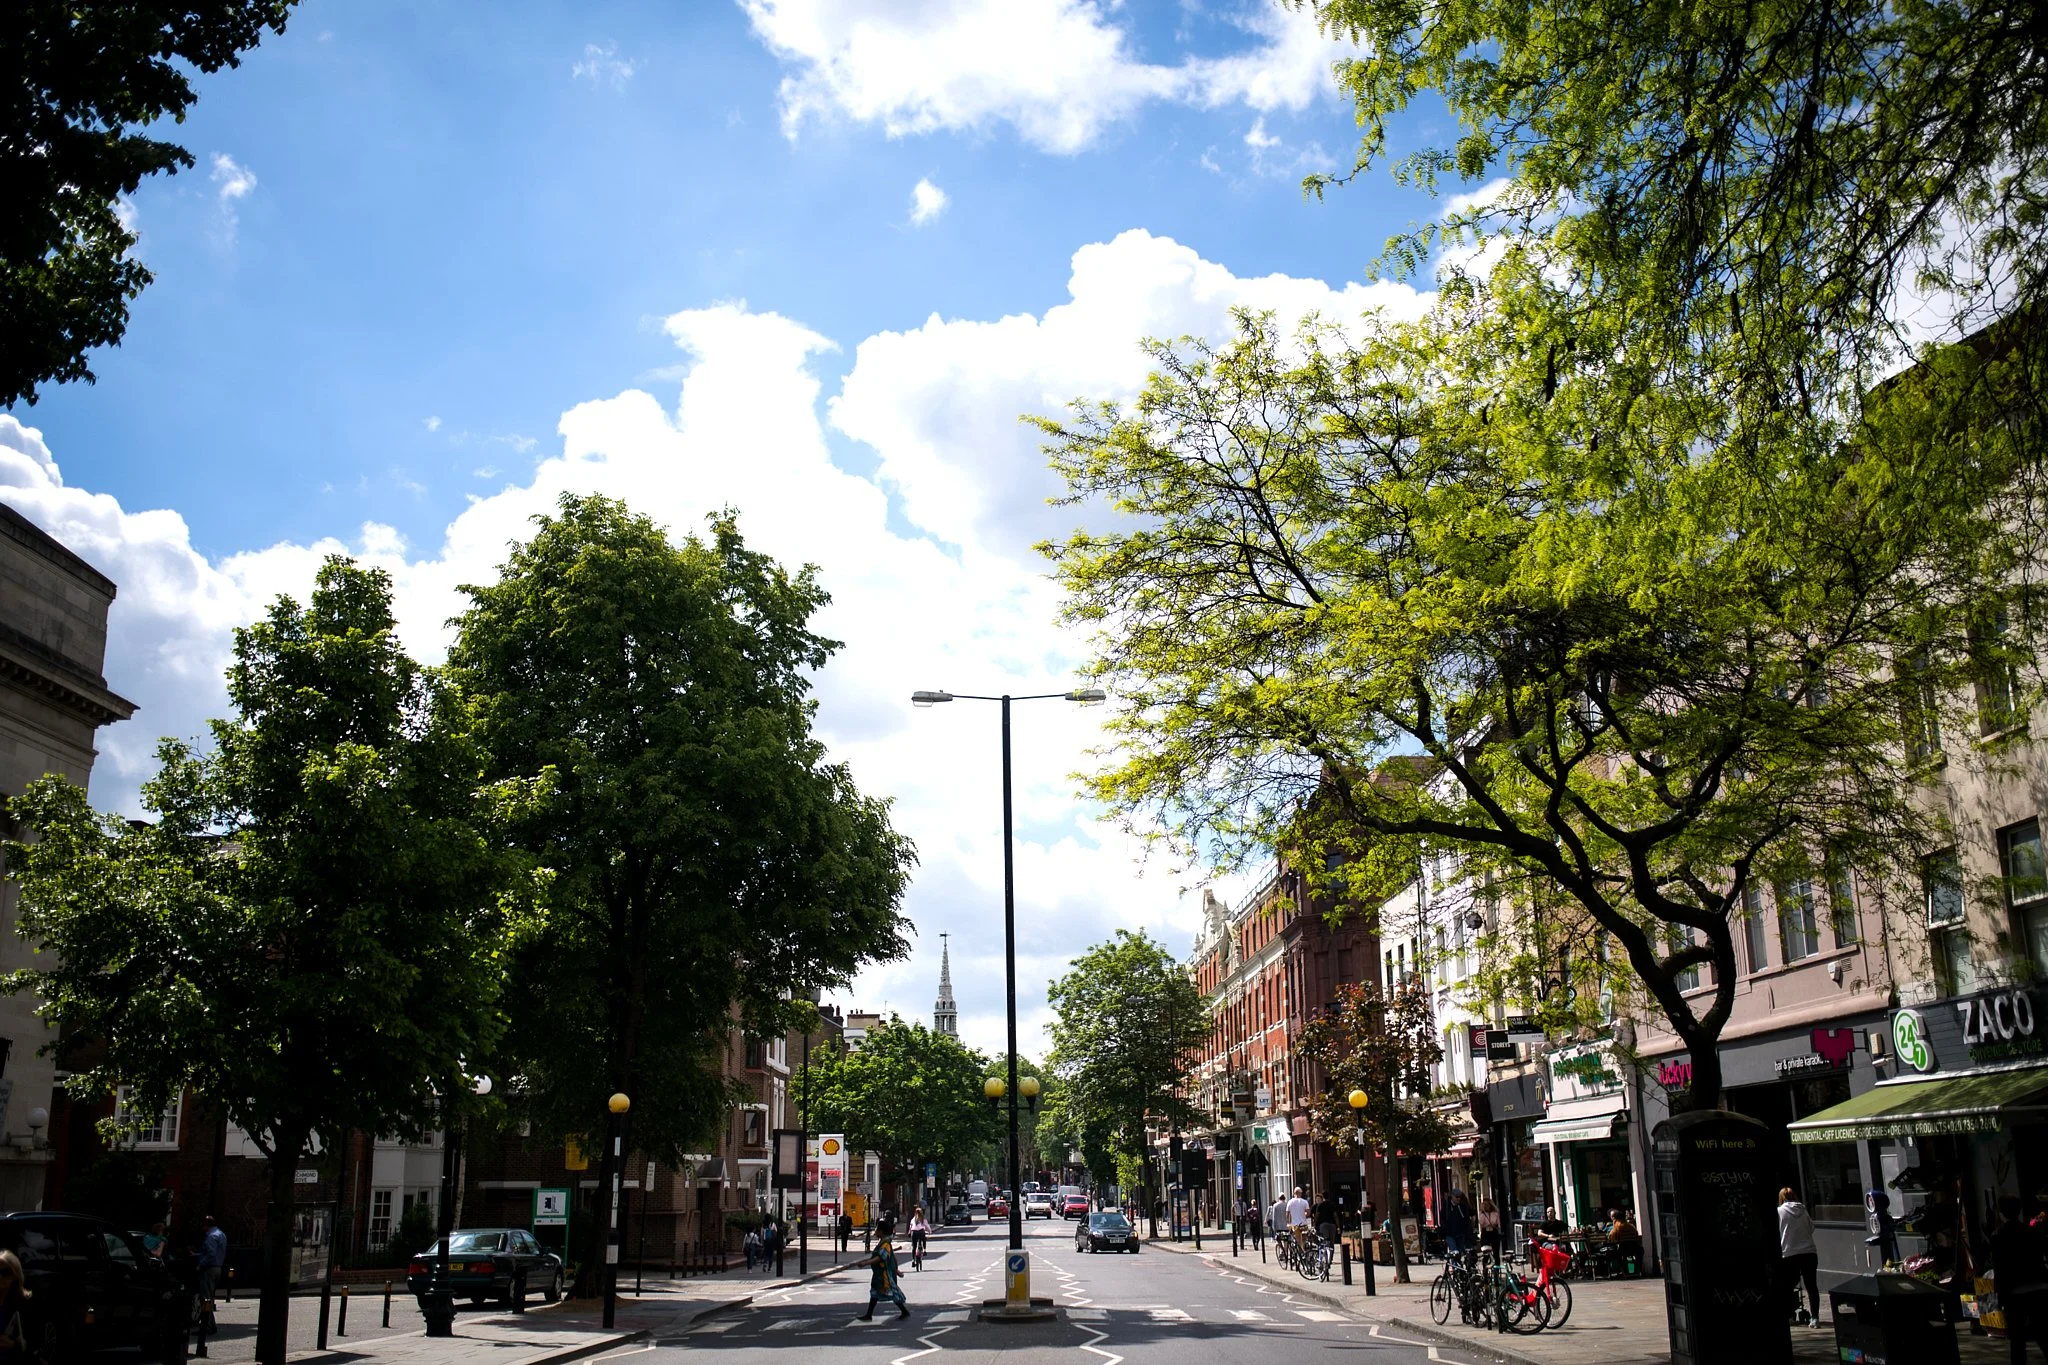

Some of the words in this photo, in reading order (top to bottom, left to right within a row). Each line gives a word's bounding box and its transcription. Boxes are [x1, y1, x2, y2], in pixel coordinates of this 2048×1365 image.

[1957, 990, 2034, 1044] ZACO
[1899, 1024, 1915, 1048] 24
[1774, 1060, 1782, 1071] bar
[1788, 1058, 1804, 1071] private
[1791, 1130, 1823, 1142] CONTINENTAL
[1824, 1129, 1835, 1140] OFF
[1835, 1128, 1856, 1140] LICENCE
[1858, 1126, 1888, 1138] GROCERIES
[1890, 1123, 1915, 1136] ORGANIC
[1915, 1120, 1947, 1134] PRODUCTS
[1695, 1139, 1718, 1150] WiFi
[1721, 1138, 1744, 1149] here
